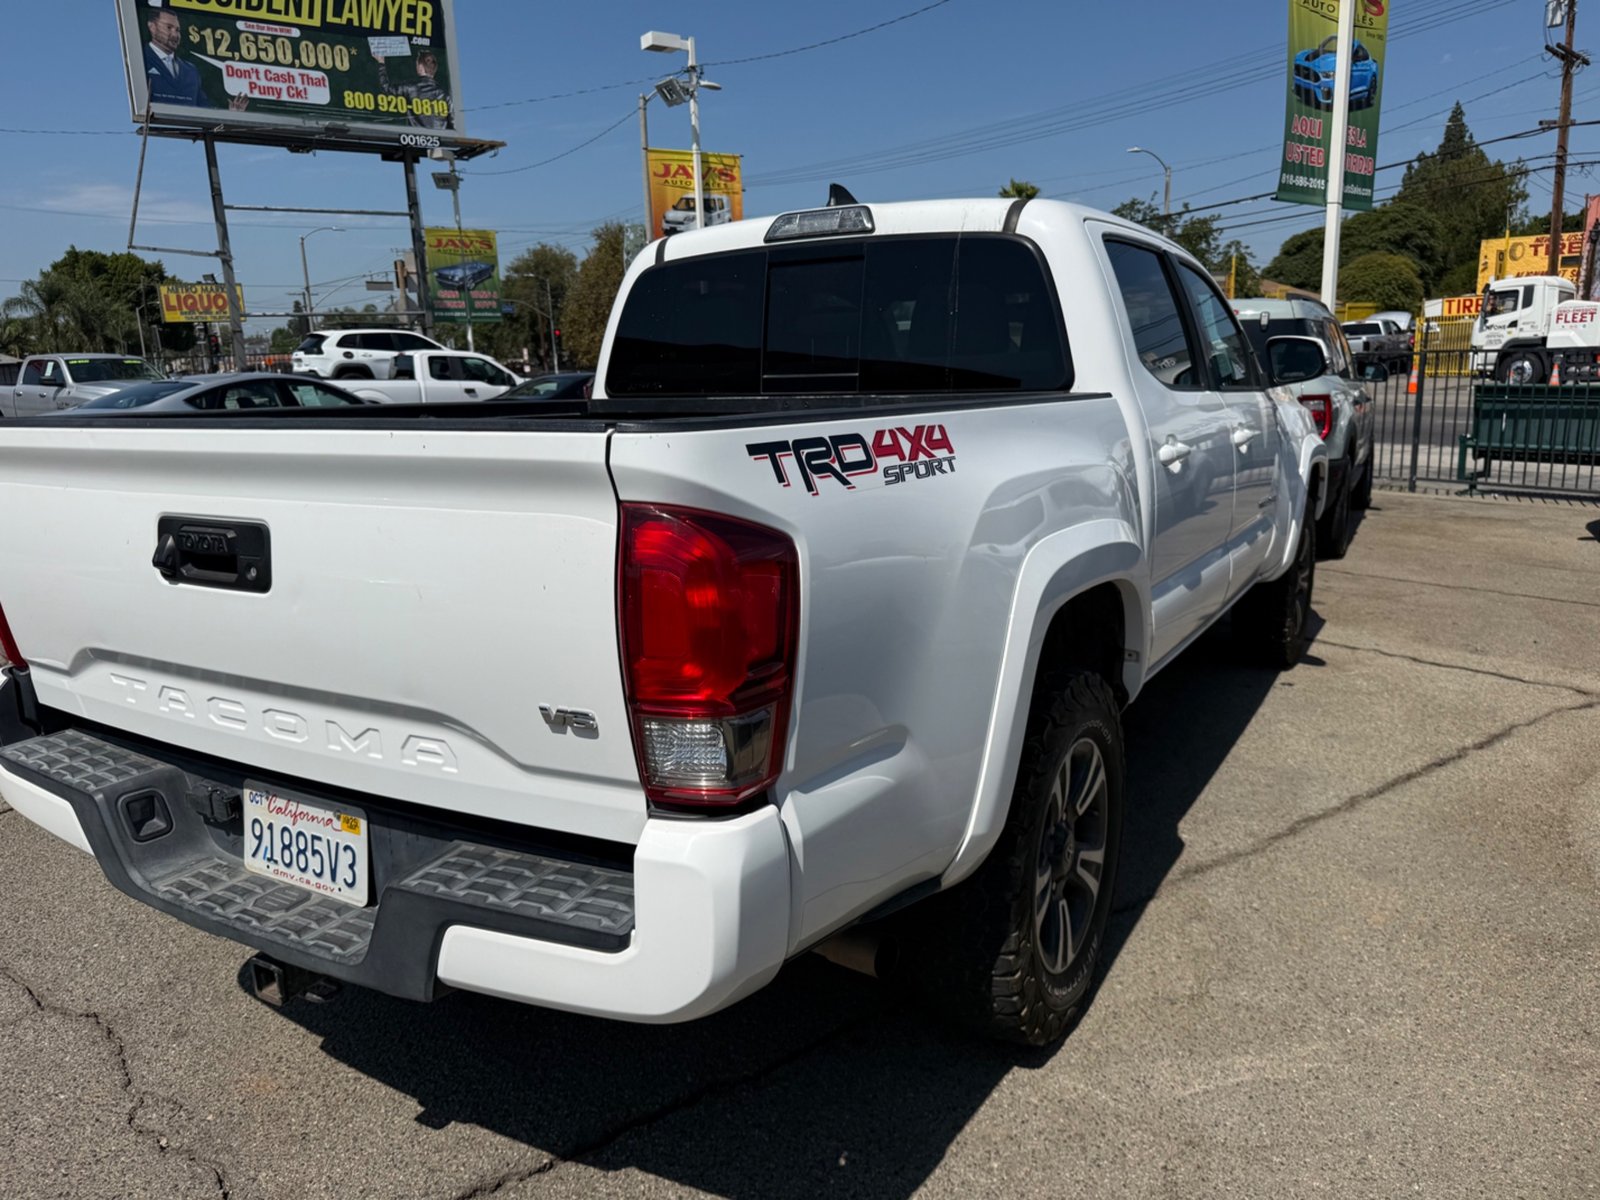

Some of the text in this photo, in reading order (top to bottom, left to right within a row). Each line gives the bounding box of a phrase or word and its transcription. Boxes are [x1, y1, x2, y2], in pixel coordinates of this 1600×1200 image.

[326, 0, 433, 37] LAWYER
[410, 36, 431, 46] .com
[225, 64, 327, 88] Don't Cash That
[248, 81, 308, 99] Puny Ck!
[343, 90, 375, 110] 800
[377, 94, 449, 117] 920-0810
[1291, 113, 1323, 140] AQUI
[400, 134, 440, 147] 001625
[1285, 141, 1325, 168] USTED
[663, 179, 692, 187] AUTO
[164, 293, 242, 312] LIQUO
[1555, 311, 1597, 325] FLEET
[745, 424, 955, 496] TRD 4X4
[883, 456, 956, 485] SPORT
[179, 532, 228, 552] TOYOTA
[110, 672, 459, 774] TACOMA
[539, 702, 600, 740] V6
[249, 791, 263, 805] OCT
[267, 794, 342, 832] California
[251, 817, 356, 889] 91885V3
[272, 868, 336, 893] dmv.ca.gov
